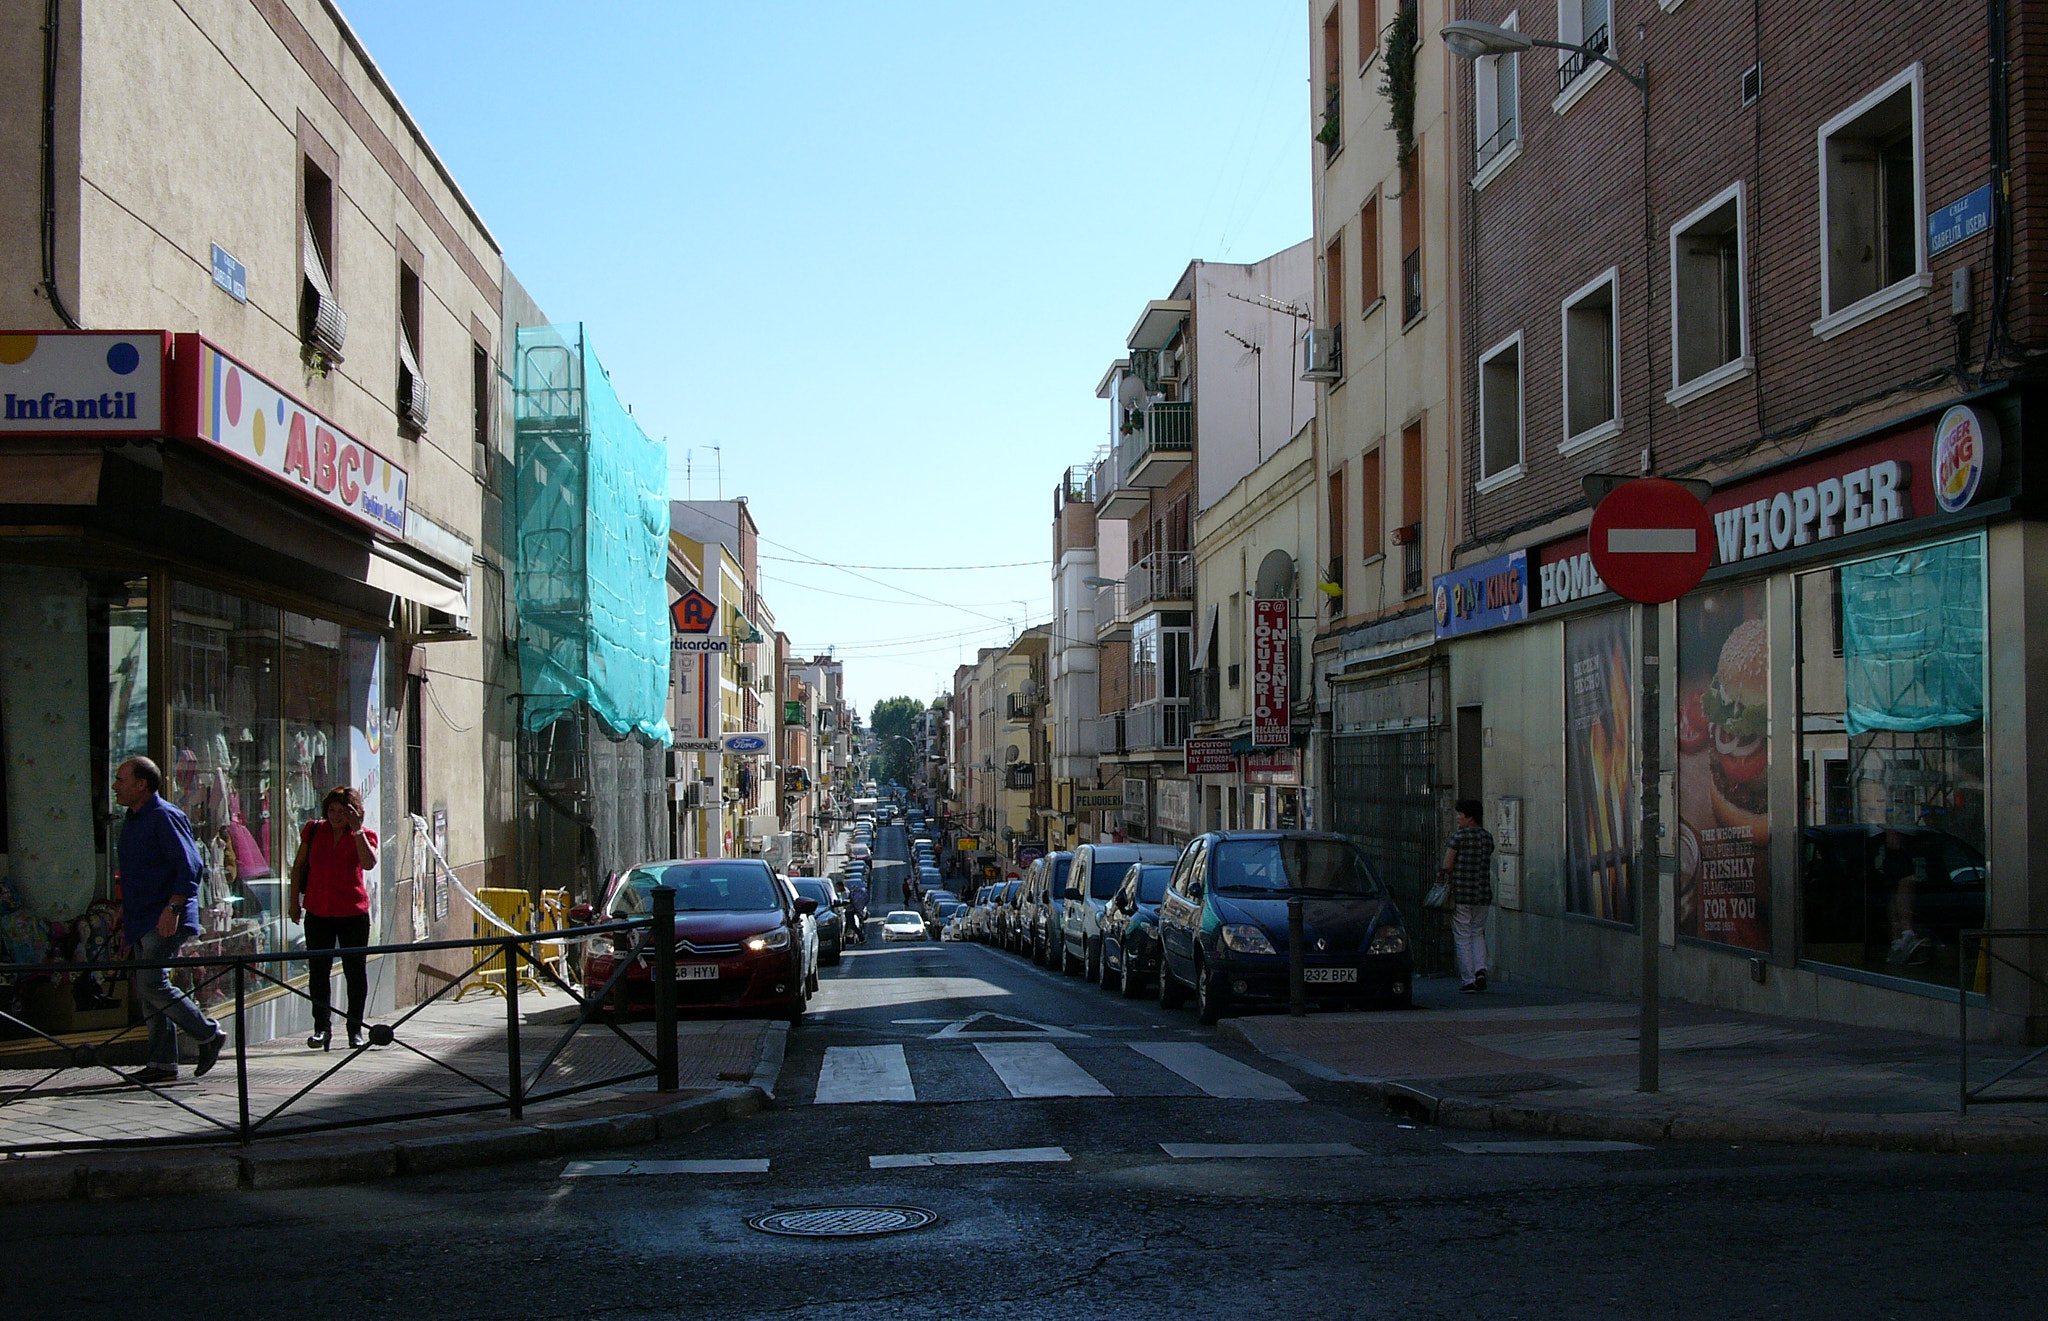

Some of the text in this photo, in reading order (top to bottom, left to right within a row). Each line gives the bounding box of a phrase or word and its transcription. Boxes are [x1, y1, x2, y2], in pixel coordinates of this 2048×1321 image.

[1949, 198, 1969, 217] CALLE
[1965, 212, 1987, 236] USERA
[5, 392, 137, 419] Infantil
[284, 410, 361, 506] ABC
[1714, 460, 1902, 564] WHOPPER
[1453, 578, 1482, 620] PLAY
[1486, 568, 1520, 609] KING
[671, 638, 727, 650] rticardan
[1255, 614, 1271, 718] LOCUTORIO
[1272, 617, 1287, 710] INTERNET
[1264, 717, 1278, 726] FAX
[733, 738, 758, 749] Ford
[1256, 734, 1287, 743] TARJETAS
[669, 741, 718, 750] RANSMISIONES
[1189, 741, 1231, 749] LOCUTORI
[1203, 755, 1230, 763] FOTOCOP
[1701, 829, 1716, 841] THE
[1702, 857, 1755, 880] FRESHLY
[1703, 897, 1756, 919] FOR YOU
[1704, 921, 1720, 932] SINCE
[694, 966, 716, 977] HYV
[1305, 970, 1354, 981] 232 BPK
